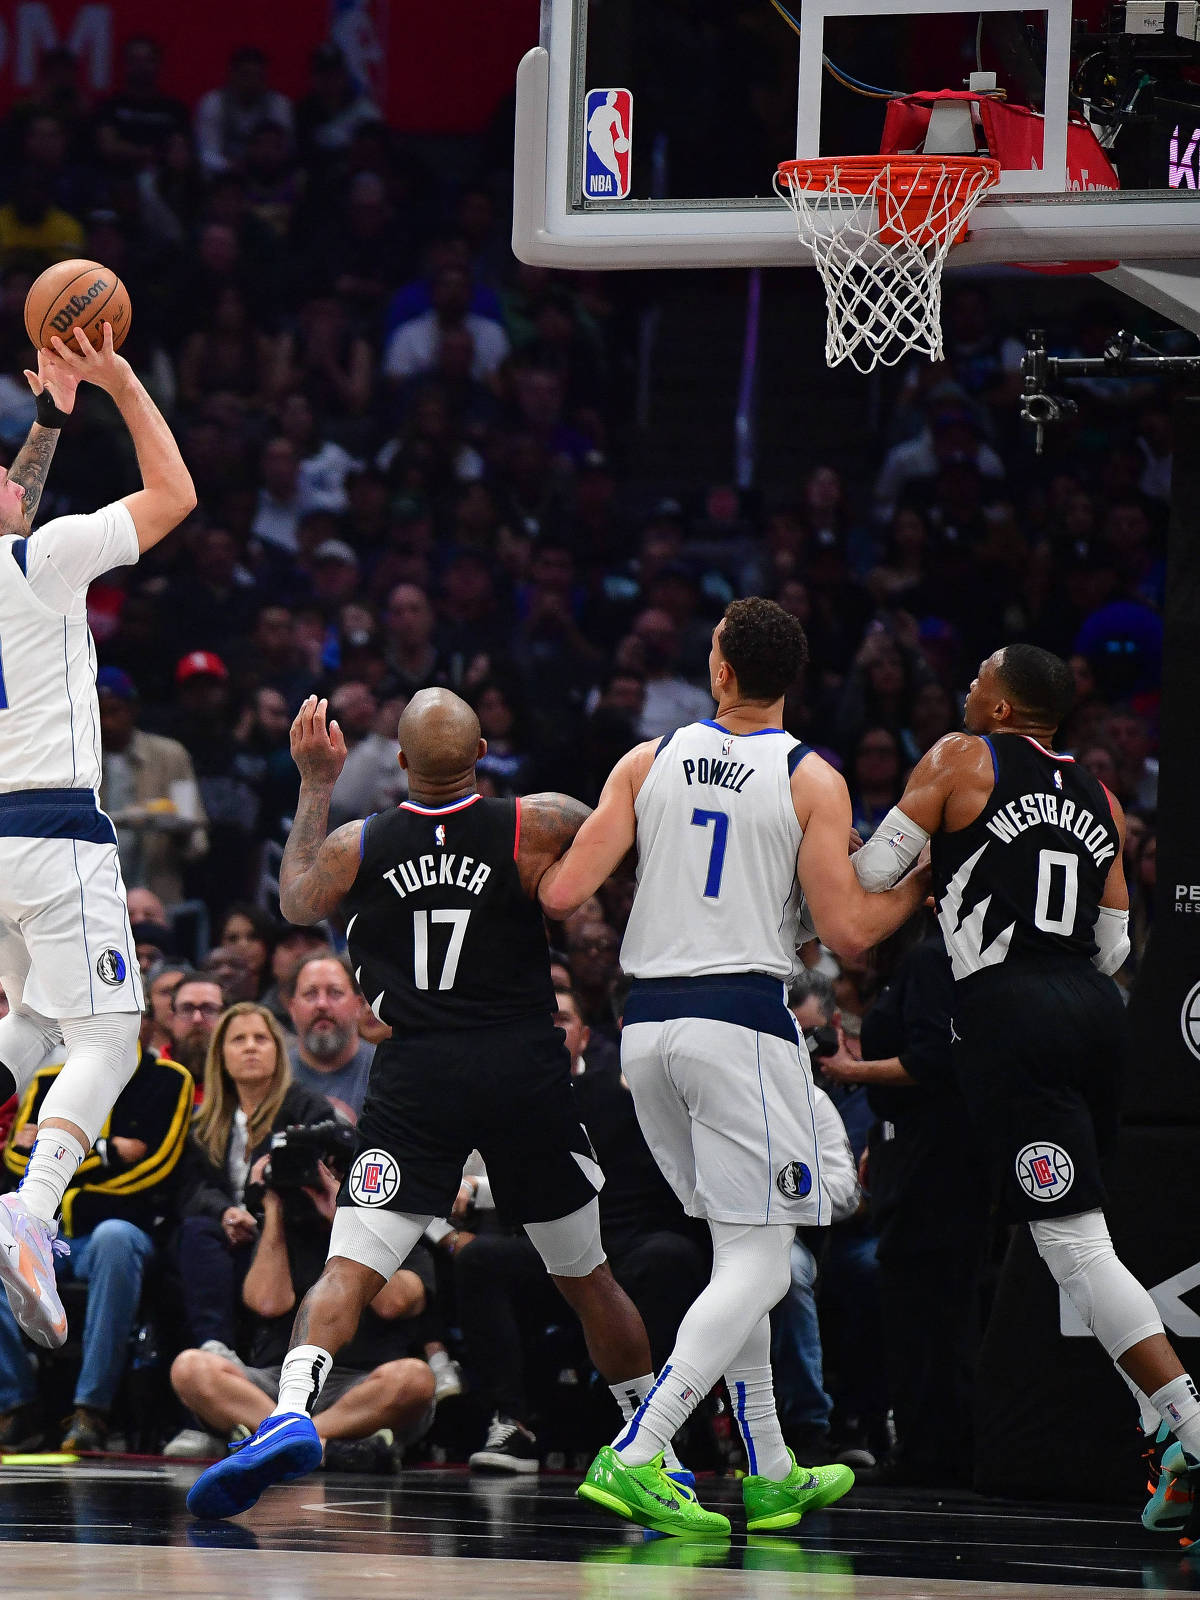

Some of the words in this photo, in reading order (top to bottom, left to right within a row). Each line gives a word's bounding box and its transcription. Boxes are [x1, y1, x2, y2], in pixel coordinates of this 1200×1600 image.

[590, 174, 612, 192] NBA
[50, 279, 108, 333] Wilson
[683, 757, 756, 794] POWELL
[690, 807, 730, 899] 7
[985, 792, 1115, 868] WESTBROOK
[382, 853, 492, 899] TUCKER
[1034, 848, 1079, 937] 0
[413, 908, 472, 991] 17
